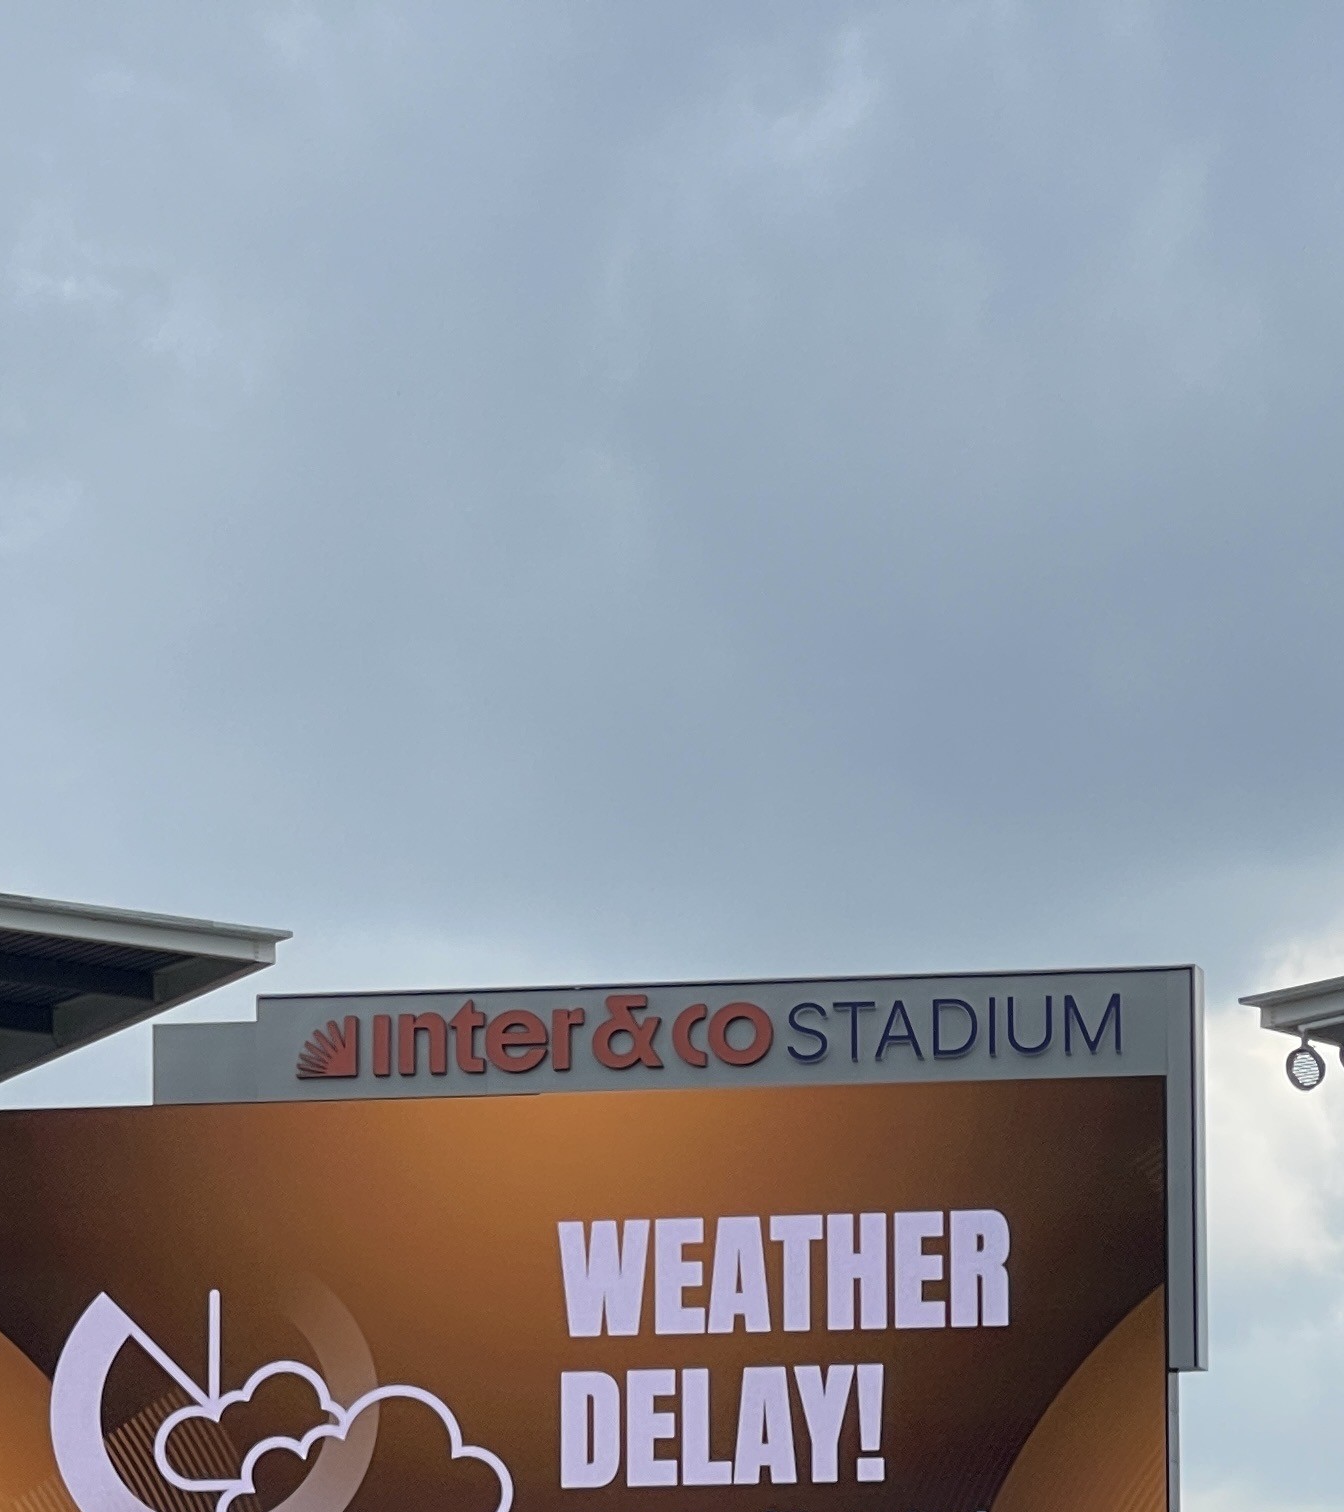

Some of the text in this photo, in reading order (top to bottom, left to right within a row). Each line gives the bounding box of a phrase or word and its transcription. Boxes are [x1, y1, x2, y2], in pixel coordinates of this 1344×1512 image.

[787, 992, 1123, 1064] STADIUM
[557, 1209, 1011, 1337] WEATHER
[560, 1363, 885, 1489] DELAY!
